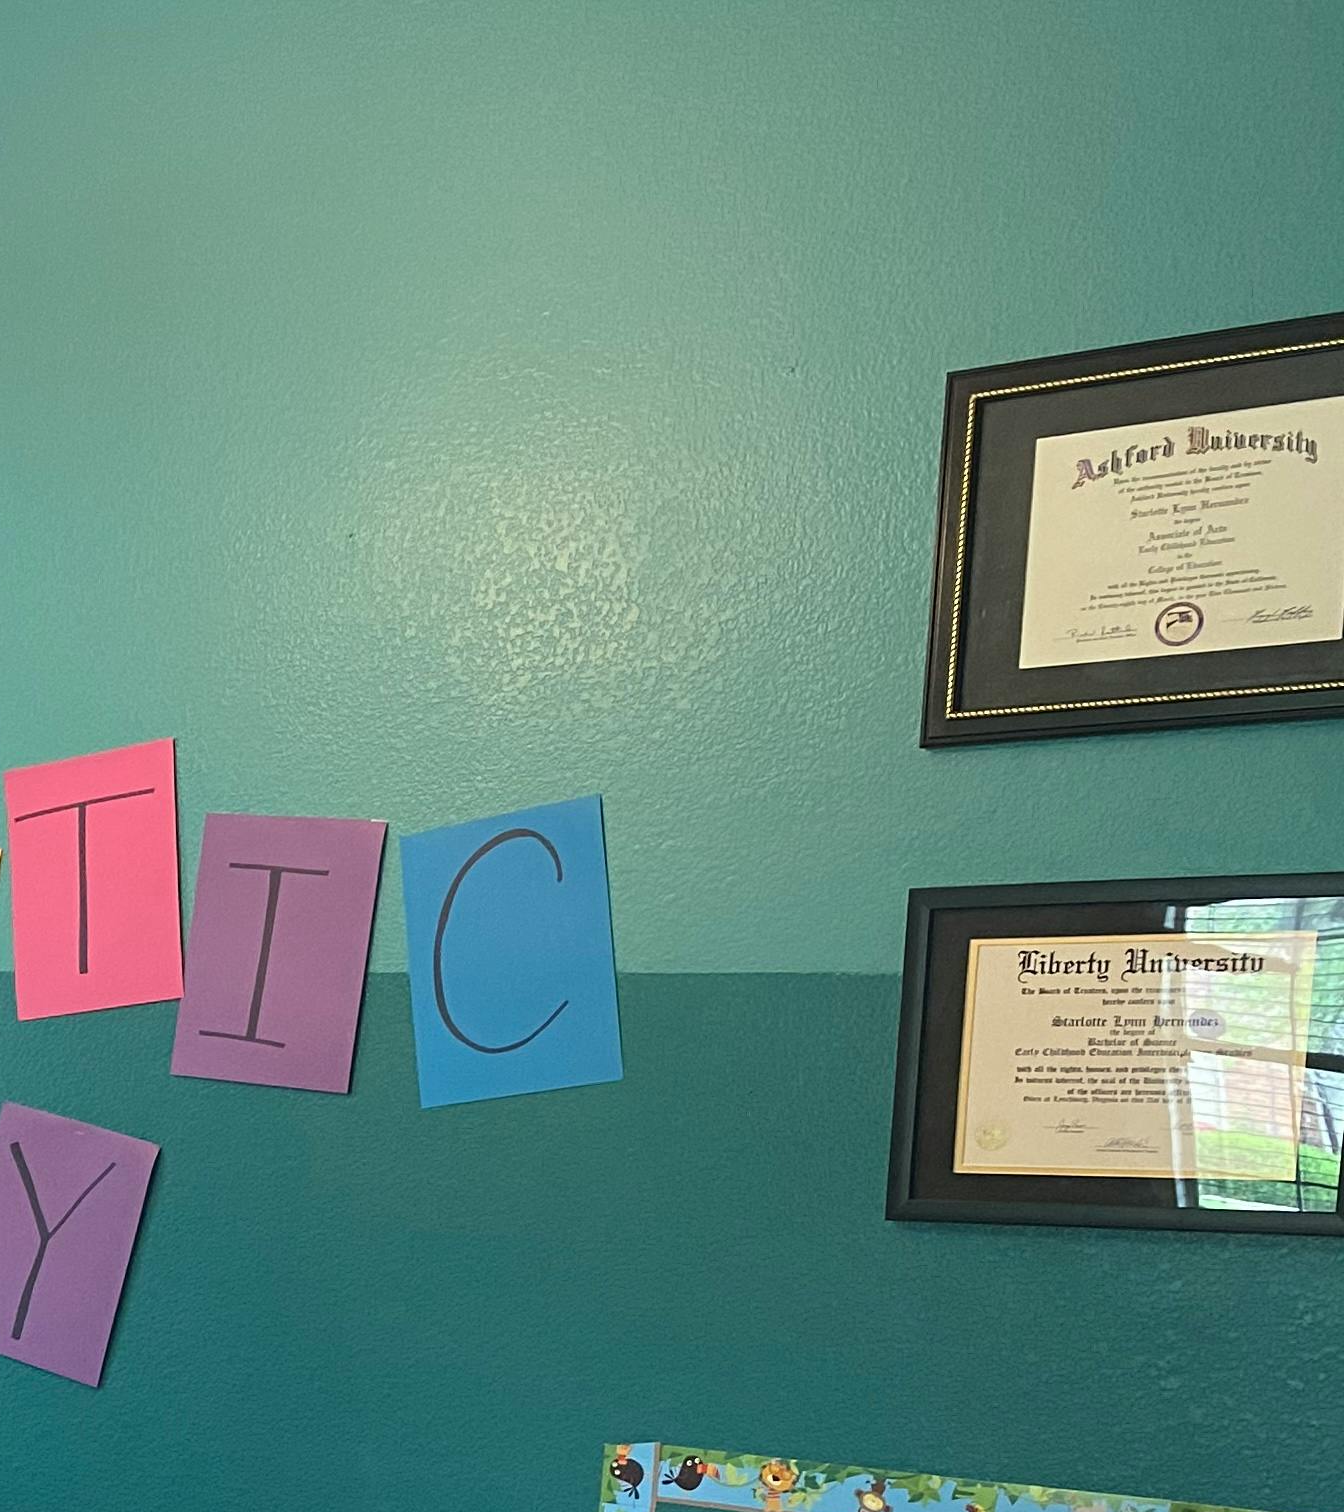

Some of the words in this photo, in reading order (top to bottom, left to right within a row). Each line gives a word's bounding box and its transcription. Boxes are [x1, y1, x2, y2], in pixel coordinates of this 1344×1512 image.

[1072, 436, 1175, 490] Ashford
[1186, 426, 1318, 463] University
[1018, 949, 1111, 983] Liberty
[1120, 948, 1266, 982] University
